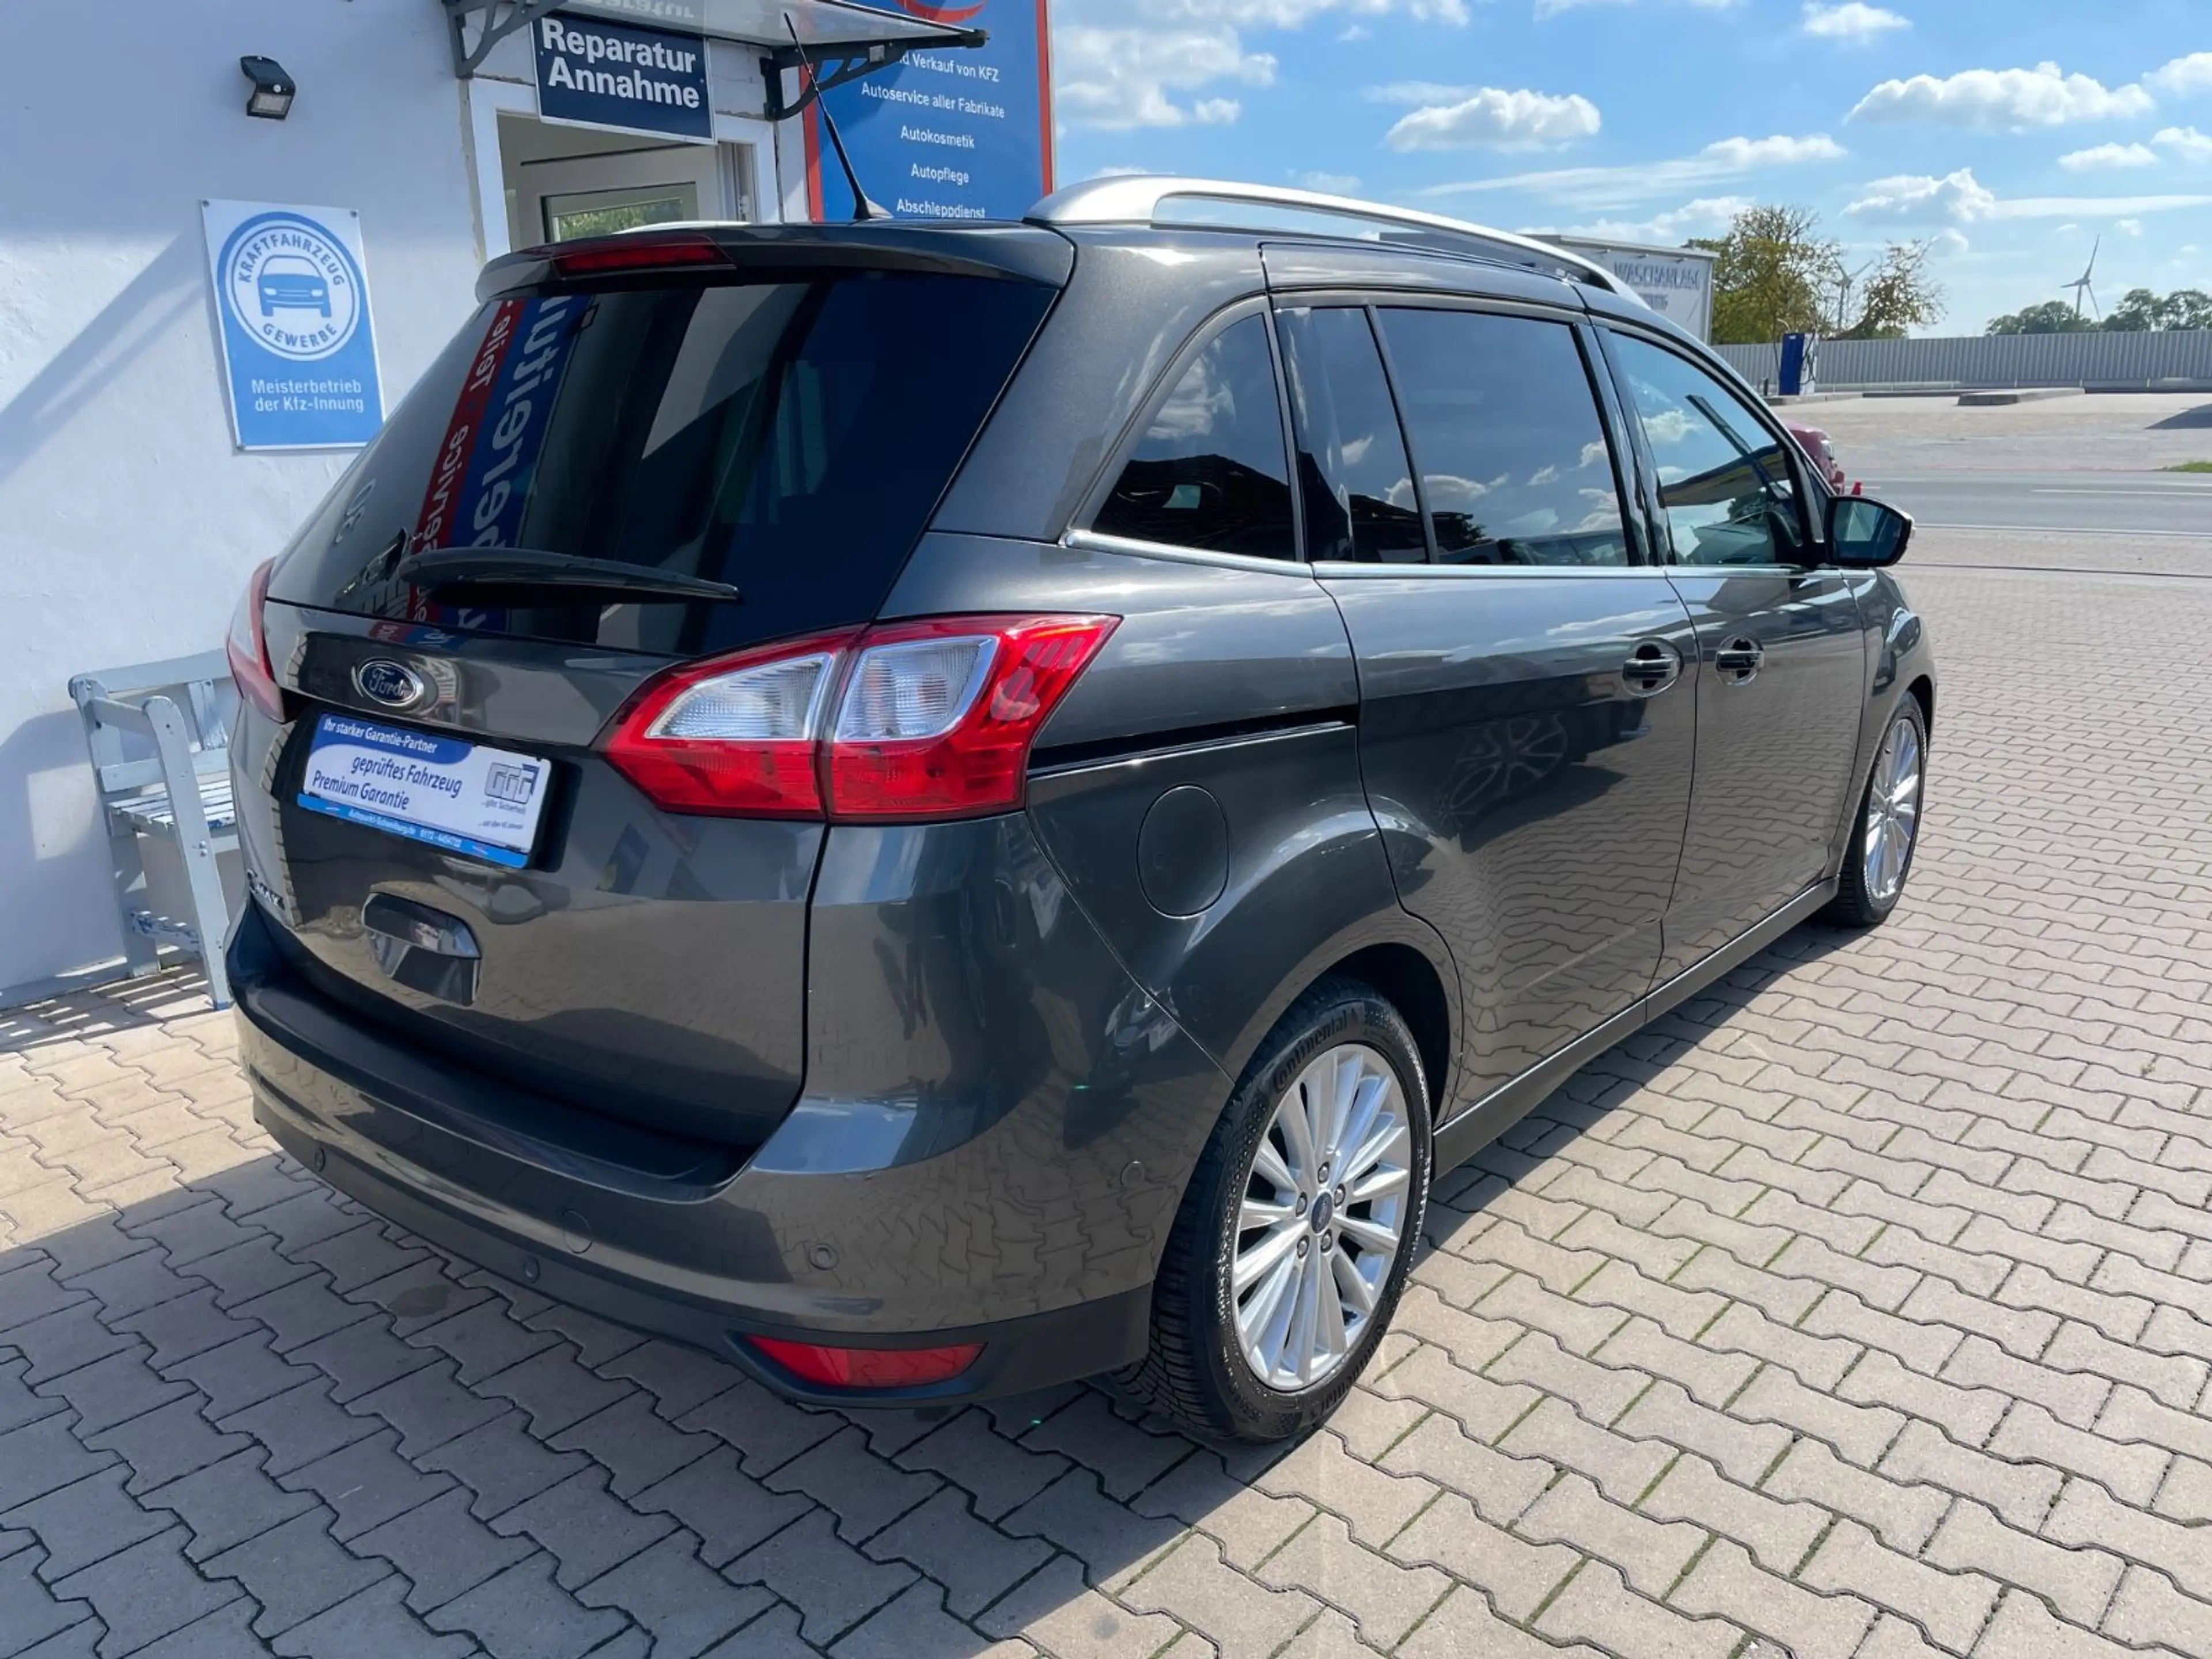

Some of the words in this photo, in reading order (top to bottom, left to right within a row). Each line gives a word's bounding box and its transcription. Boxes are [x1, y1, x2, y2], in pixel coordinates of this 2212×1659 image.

[541, 17, 696, 73] Reparatur
[912, 52, 955, 73] Verkauf
[956, 64, 976, 78] von
[979, 66, 1000, 82] KFZ
[548, 56, 700, 109] Annahme
[861, 82, 930, 107] Autoservice
[933, 94, 956, 110] aller
[958, 98, 1005, 119] Fabrikate
[900, 124, 975, 149] Autokosmetik
[911, 163, 969, 187] Autopflege
[896, 198, 986, 218] Abschleppdienst
[238, 233, 345, 286] KRAFTFAHRZEUG
[263, 323, 338, 348] GEWERBE
[252, 378, 362, 394] Meisterbetrieb
[255, 396, 279, 412] der
[283, 396, 365, 413] Kfz-Innung
[369, 667, 405, 696] Ford
[323, 718, 335, 732] Ihr
[336, 722, 365, 738] starker
[365, 727, 438, 753] Garantie-Partner
[312, 770, 359, 797] Premium
[360, 782, 410, 810] Garantie
[350, 756, 406, 779] geprüftes
[406, 764, 463, 799] Fahrzeug
